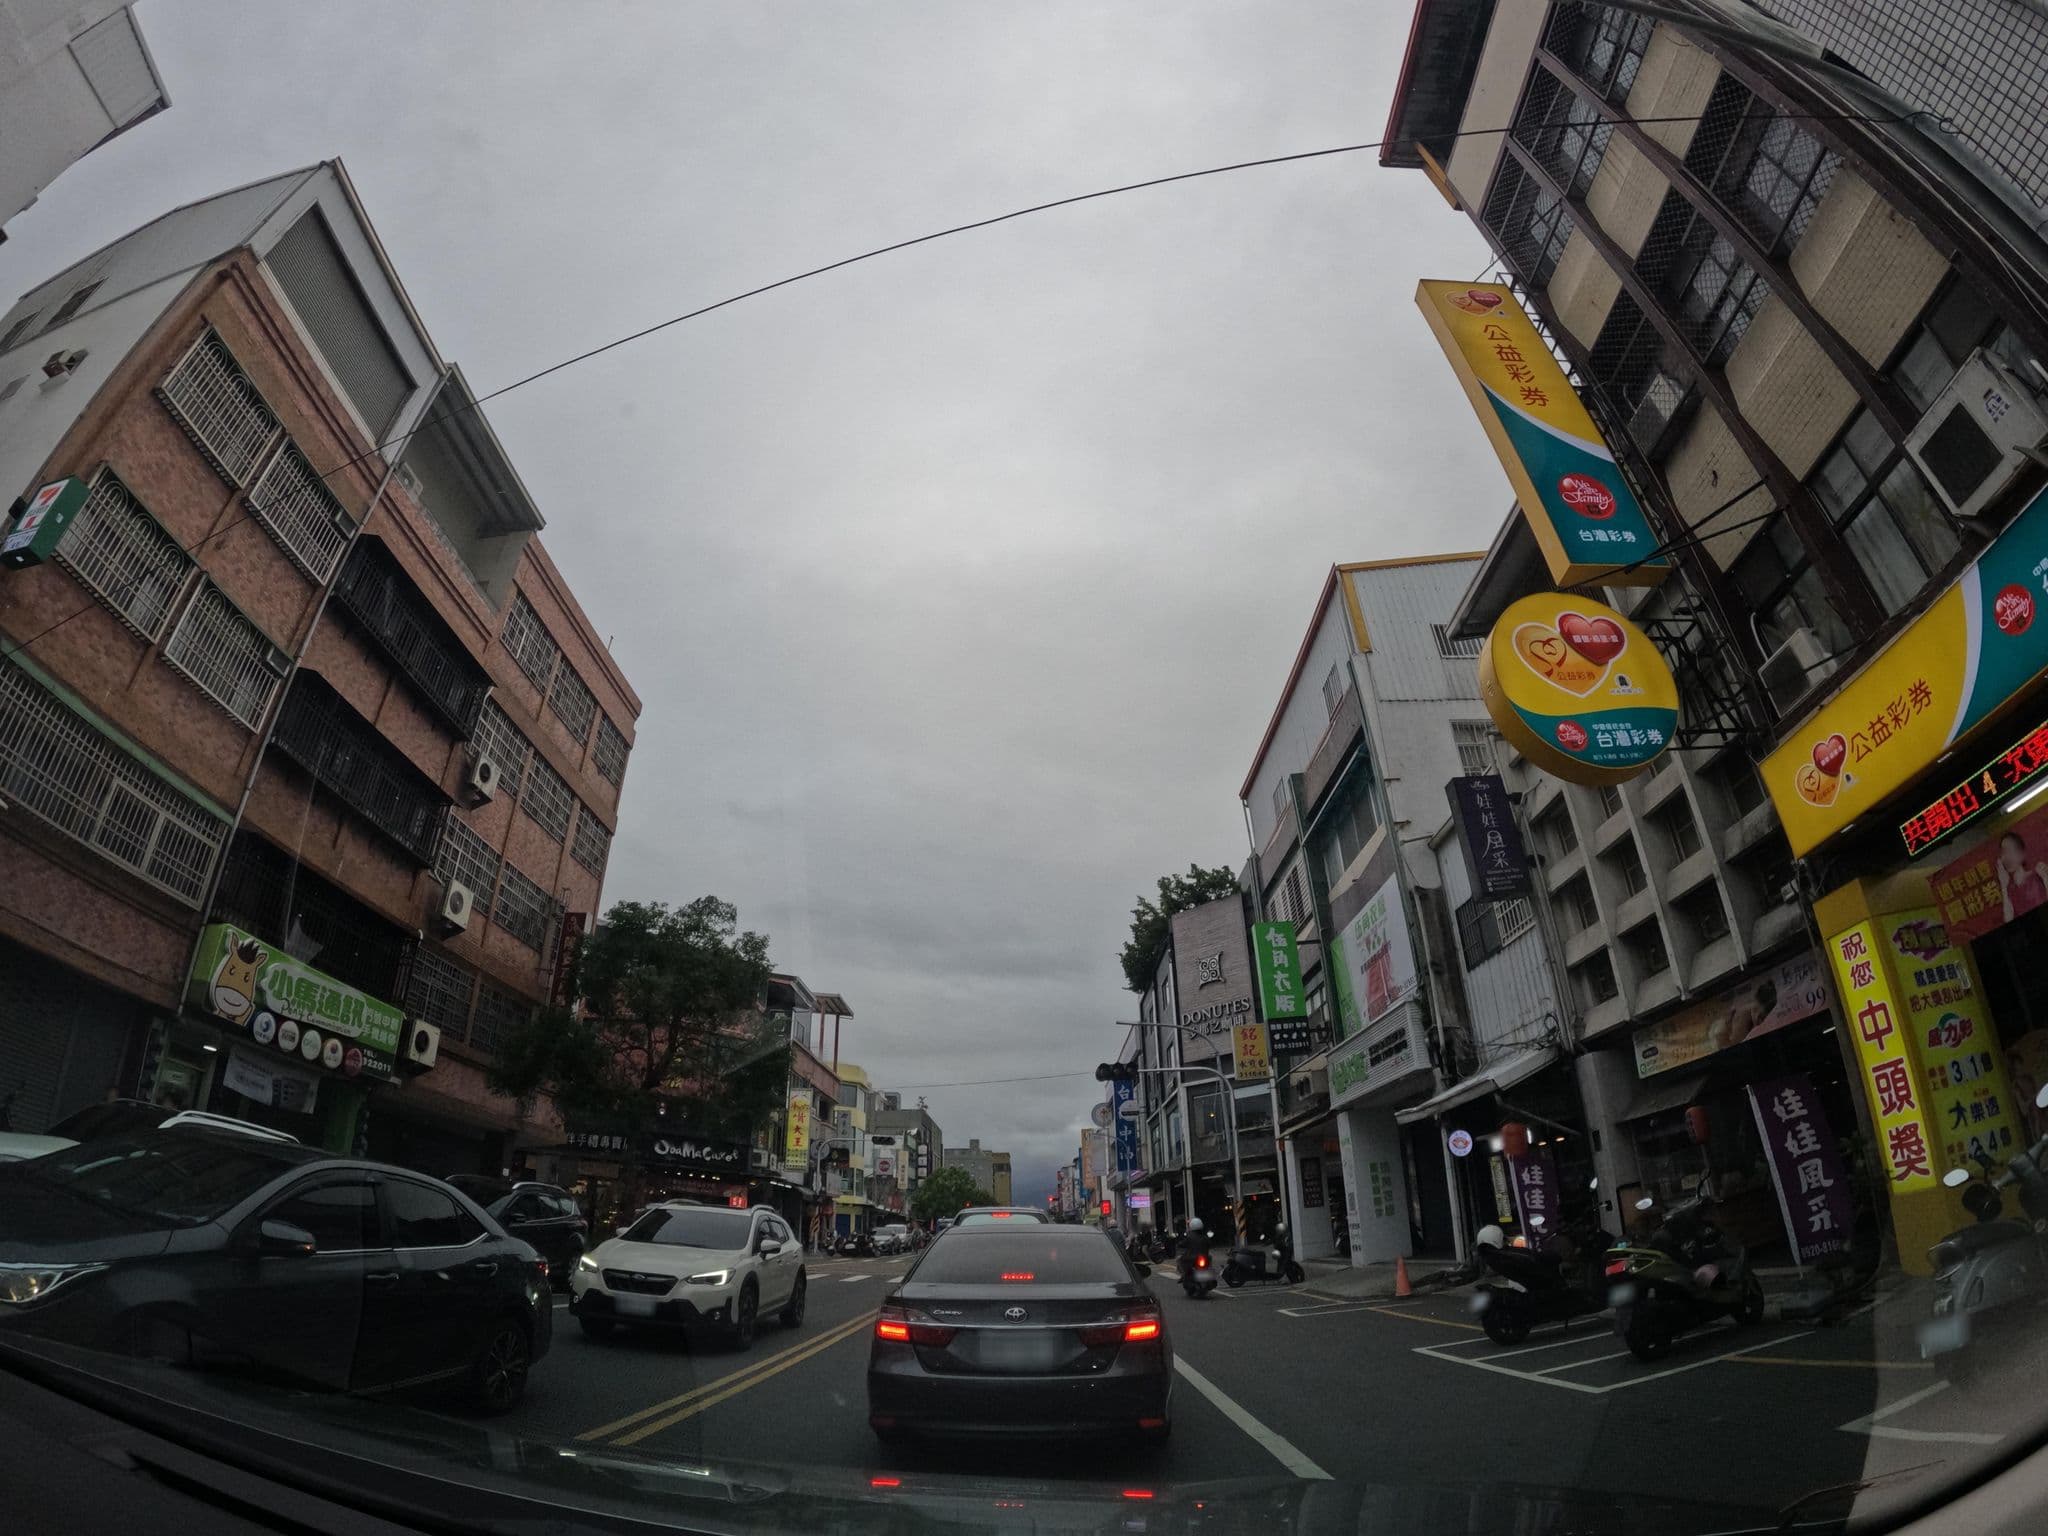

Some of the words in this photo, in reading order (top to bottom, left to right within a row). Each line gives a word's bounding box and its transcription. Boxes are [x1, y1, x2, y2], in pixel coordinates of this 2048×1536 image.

[1484, 324, 1549, 407] 公益彩券
[1596, 728, 1664, 748] 台灣彩券
[1850, 678, 1932, 763] 公益彩券
[1903, 783, 1979, 852] 共開出
[1983, 770, 1998, 795] 4
[268, 968, 366, 1029] 小馬通訊
[1182, 997, 1251, 1027] DONUTES
[1838, 931, 1931, 1182] 祝您中頭獎
[1773, 1087, 1839, 1232] 娃娃風采
